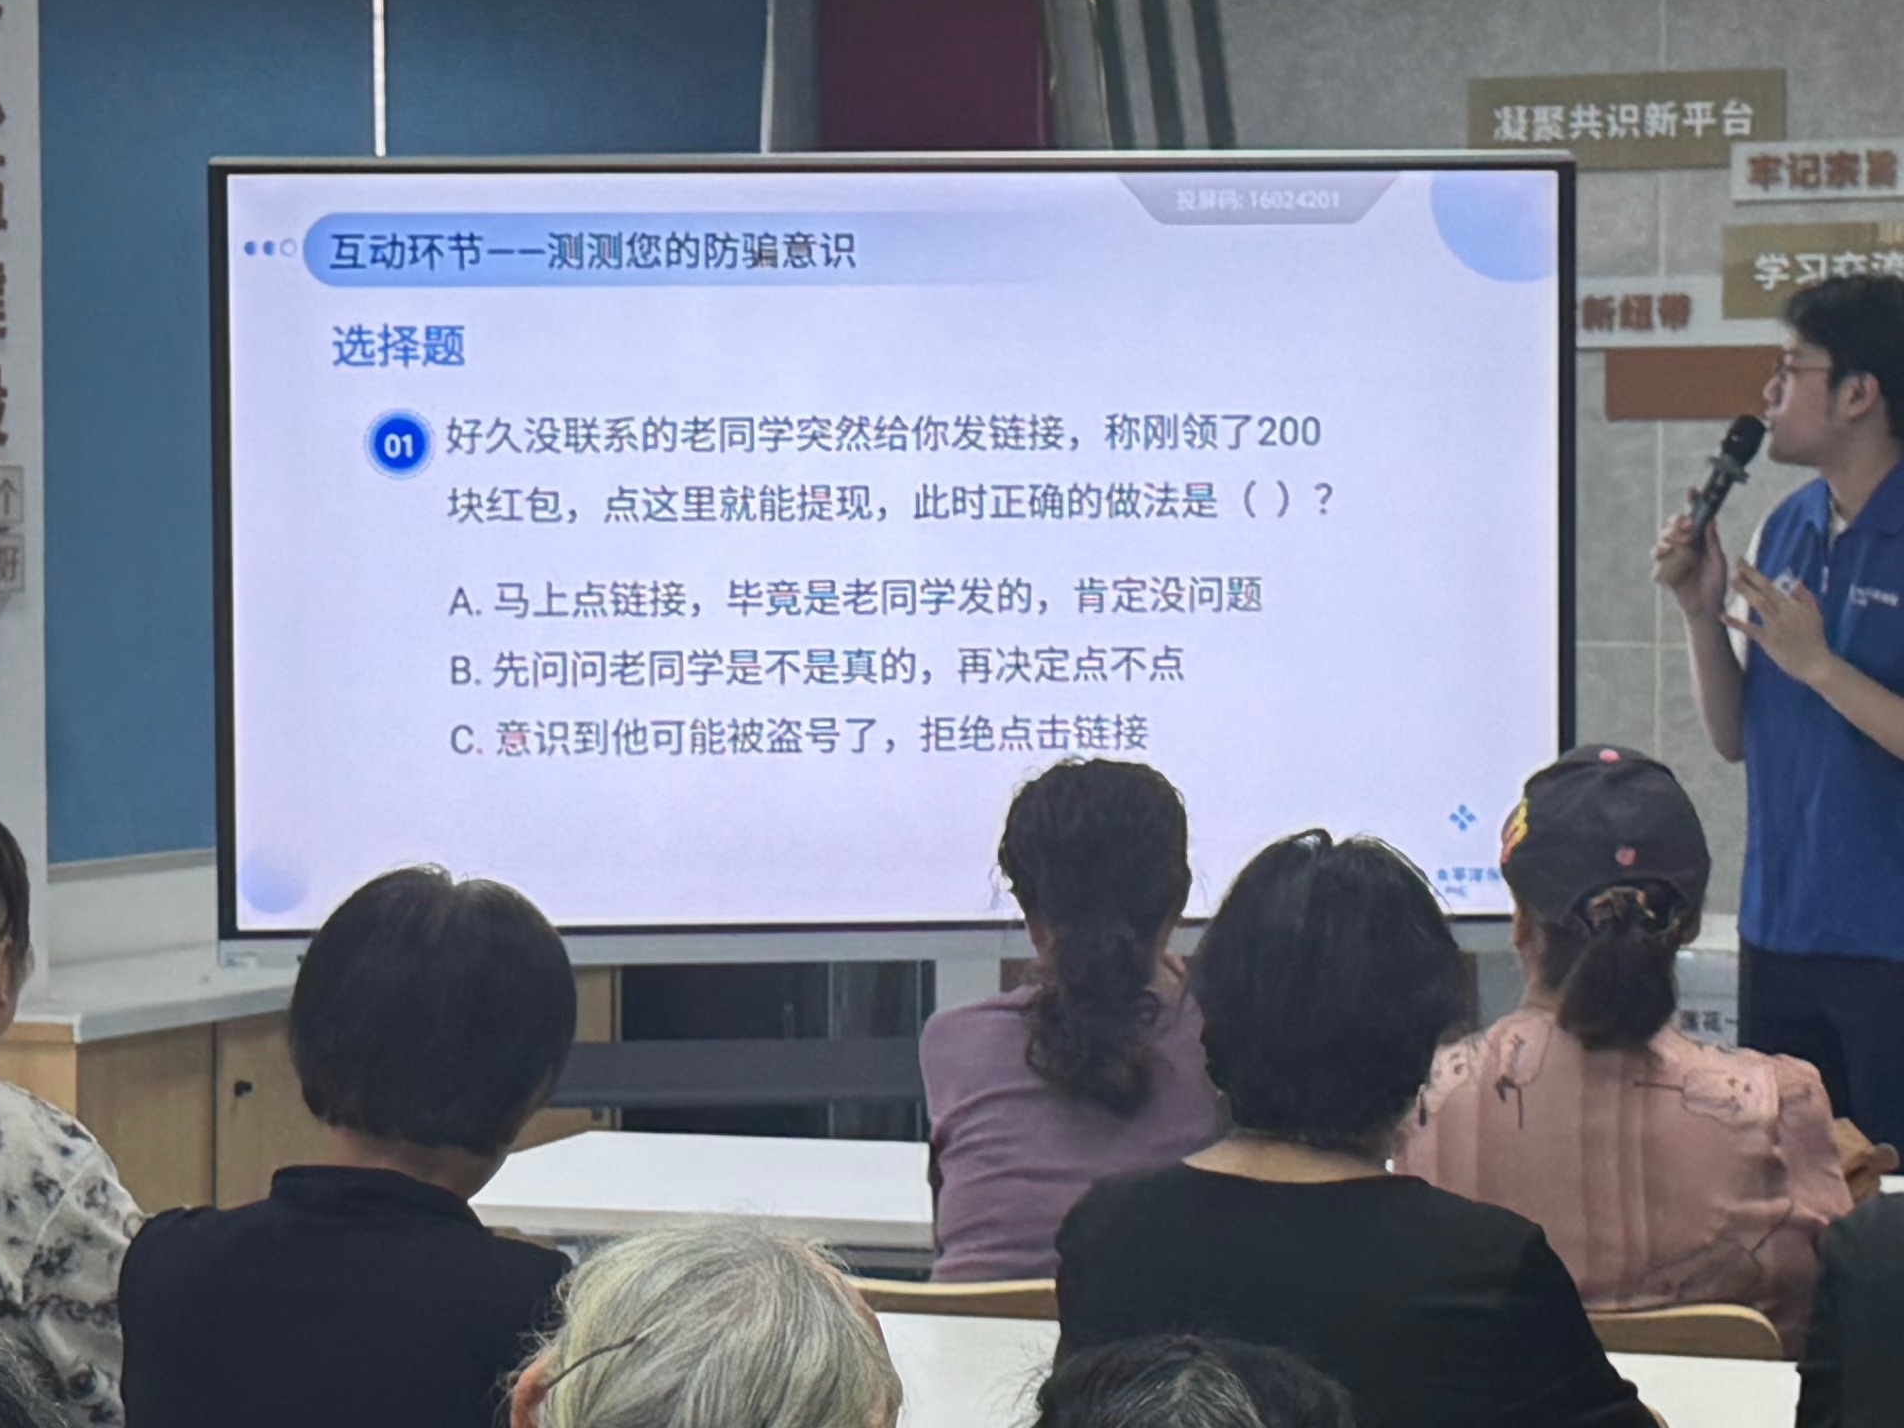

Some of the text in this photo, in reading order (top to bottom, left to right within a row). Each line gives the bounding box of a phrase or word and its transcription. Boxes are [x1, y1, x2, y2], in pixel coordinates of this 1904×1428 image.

[1492, 98, 1755, 143] 凝聚共识新平台
[1746, 149, 1900, 191] 牢记宗旨
[331, 325, 466, 368] 选择题
[383, 432, 415, 459] 01
